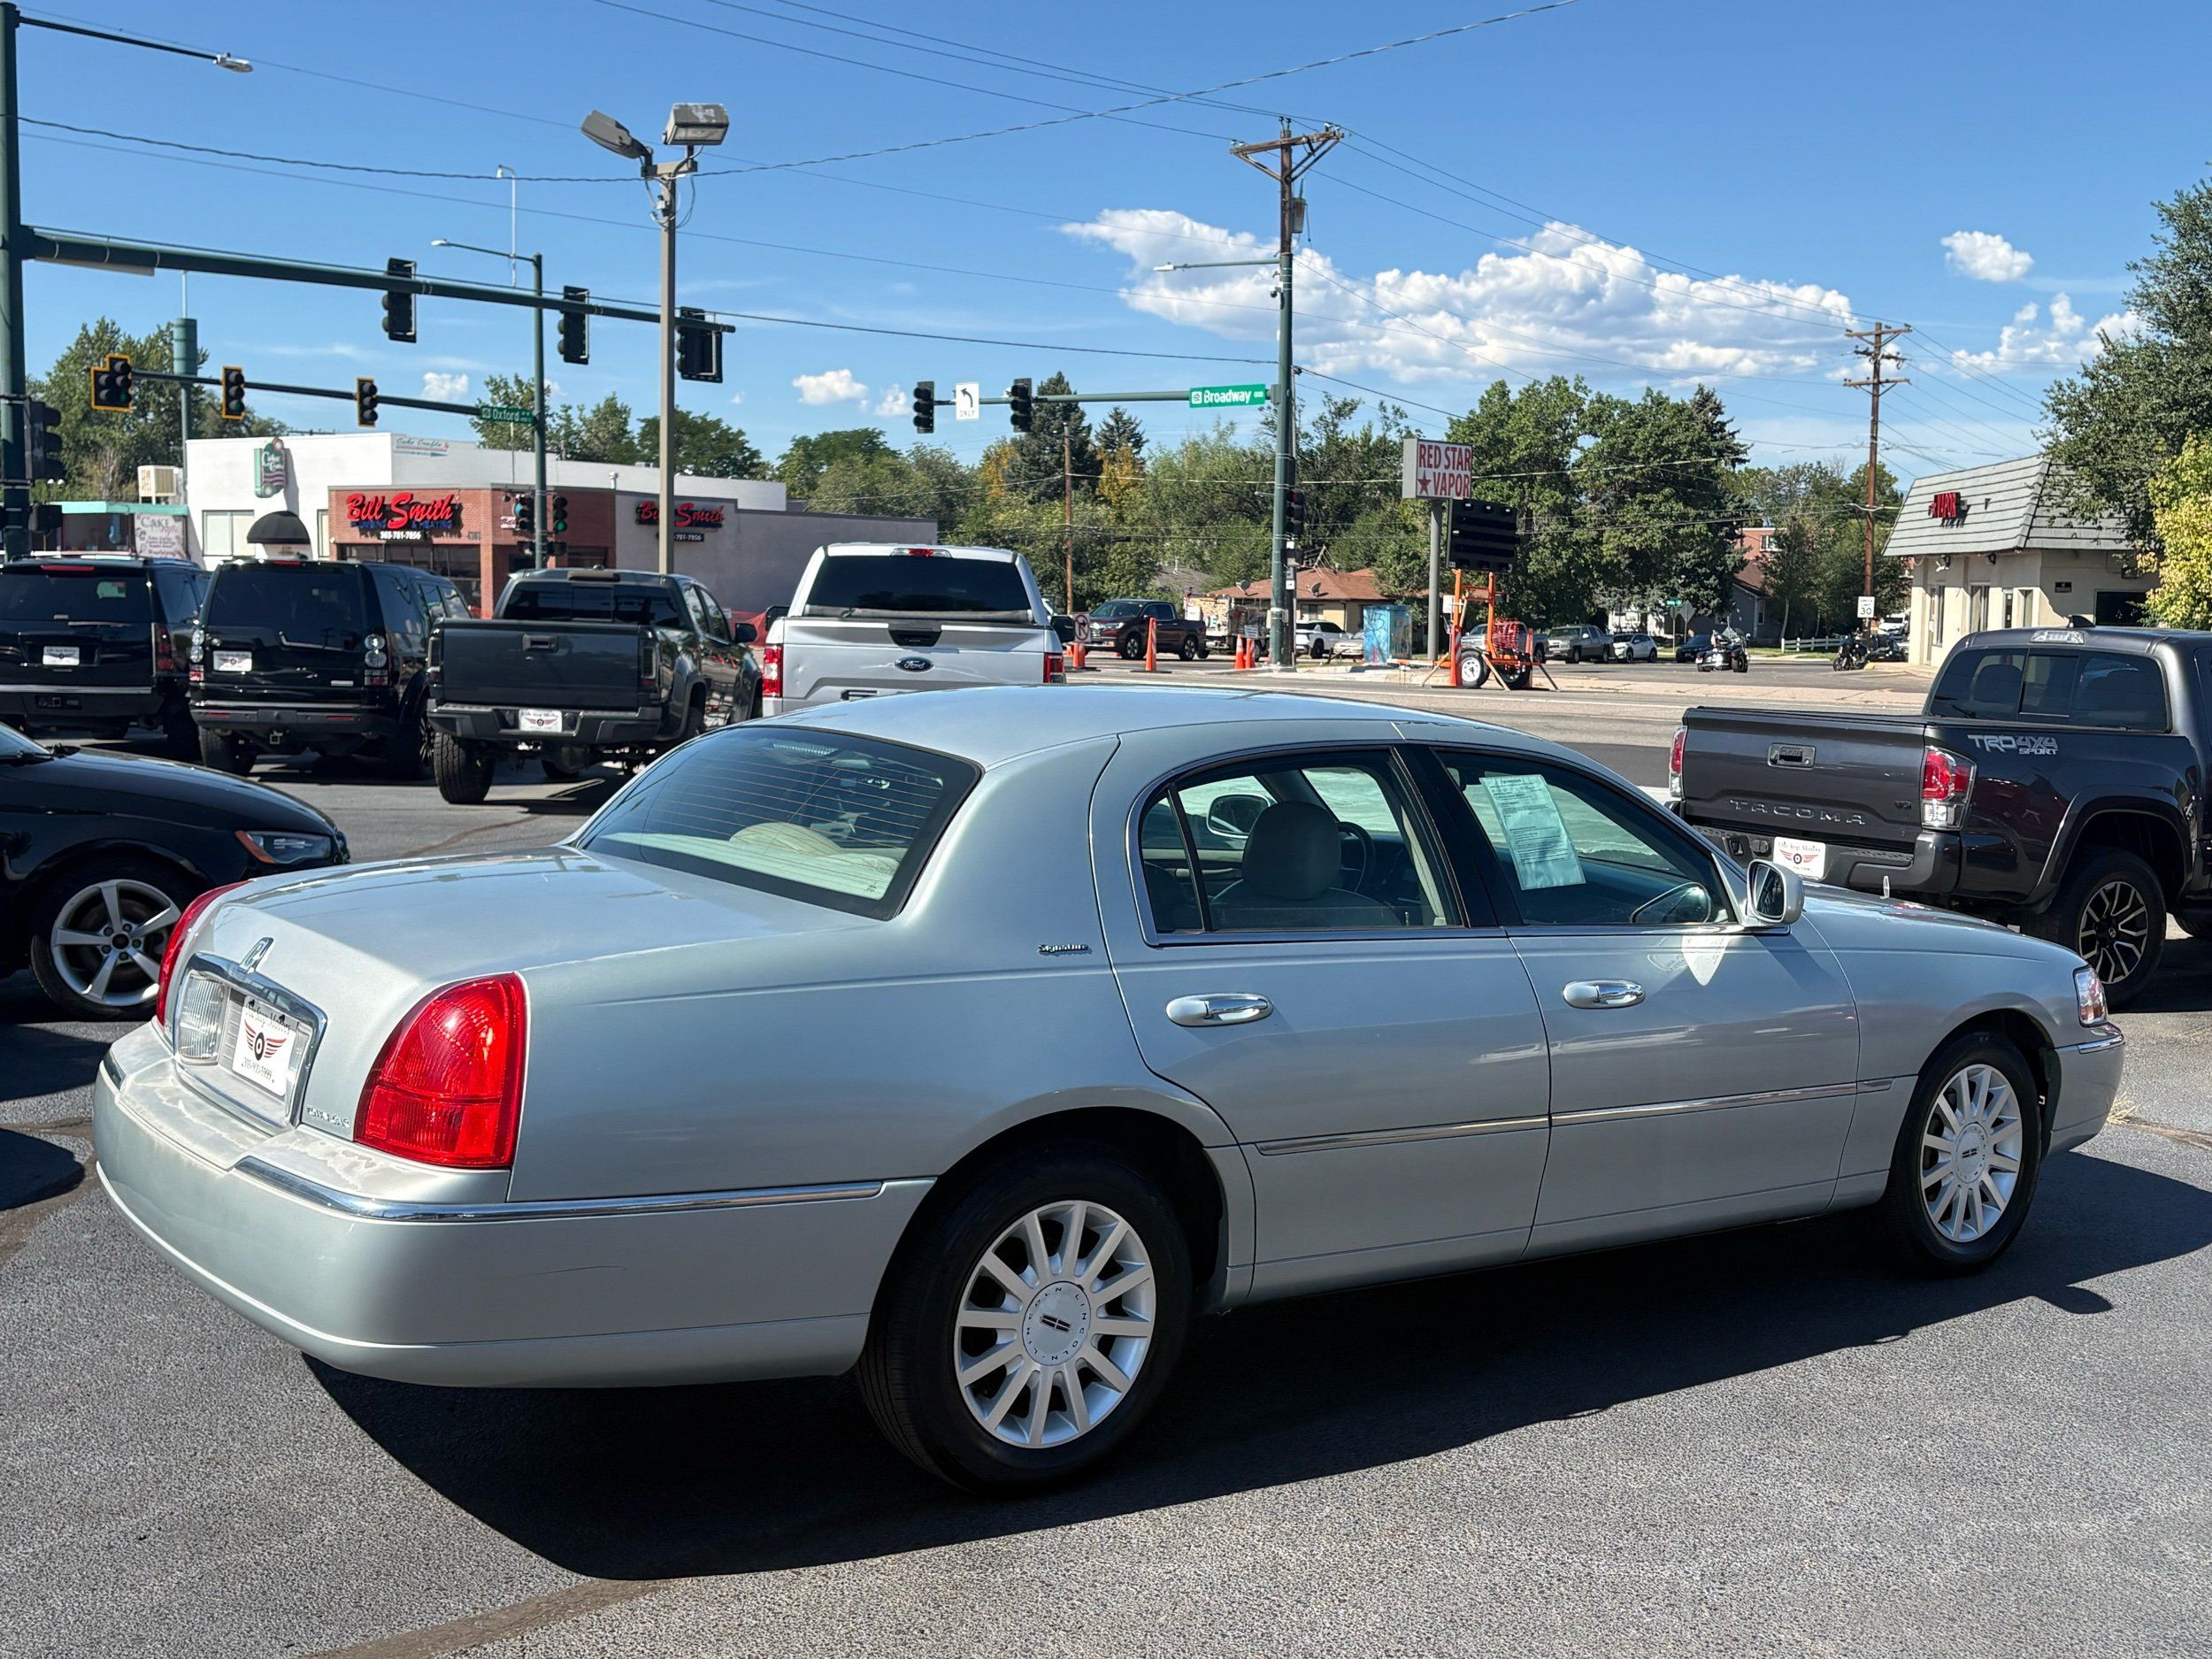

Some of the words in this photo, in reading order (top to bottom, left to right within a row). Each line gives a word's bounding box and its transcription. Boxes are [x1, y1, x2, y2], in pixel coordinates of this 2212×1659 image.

[1204, 389, 1251, 403] Broadway
[493, 409, 520, 422] Oxford
[1419, 444, 1442, 469] RED
[1444, 446, 1471, 471] STAR
[1432, 472, 1471, 497] VAPOR
[347, 493, 384, 520] Bill
[388, 492, 454, 529] Smith
[674, 503, 725, 527] Smith
[904, 660, 926, 669] Ford
[1967, 734, 2016, 753] TRD
[1730, 799, 1865, 825] TACOMA
